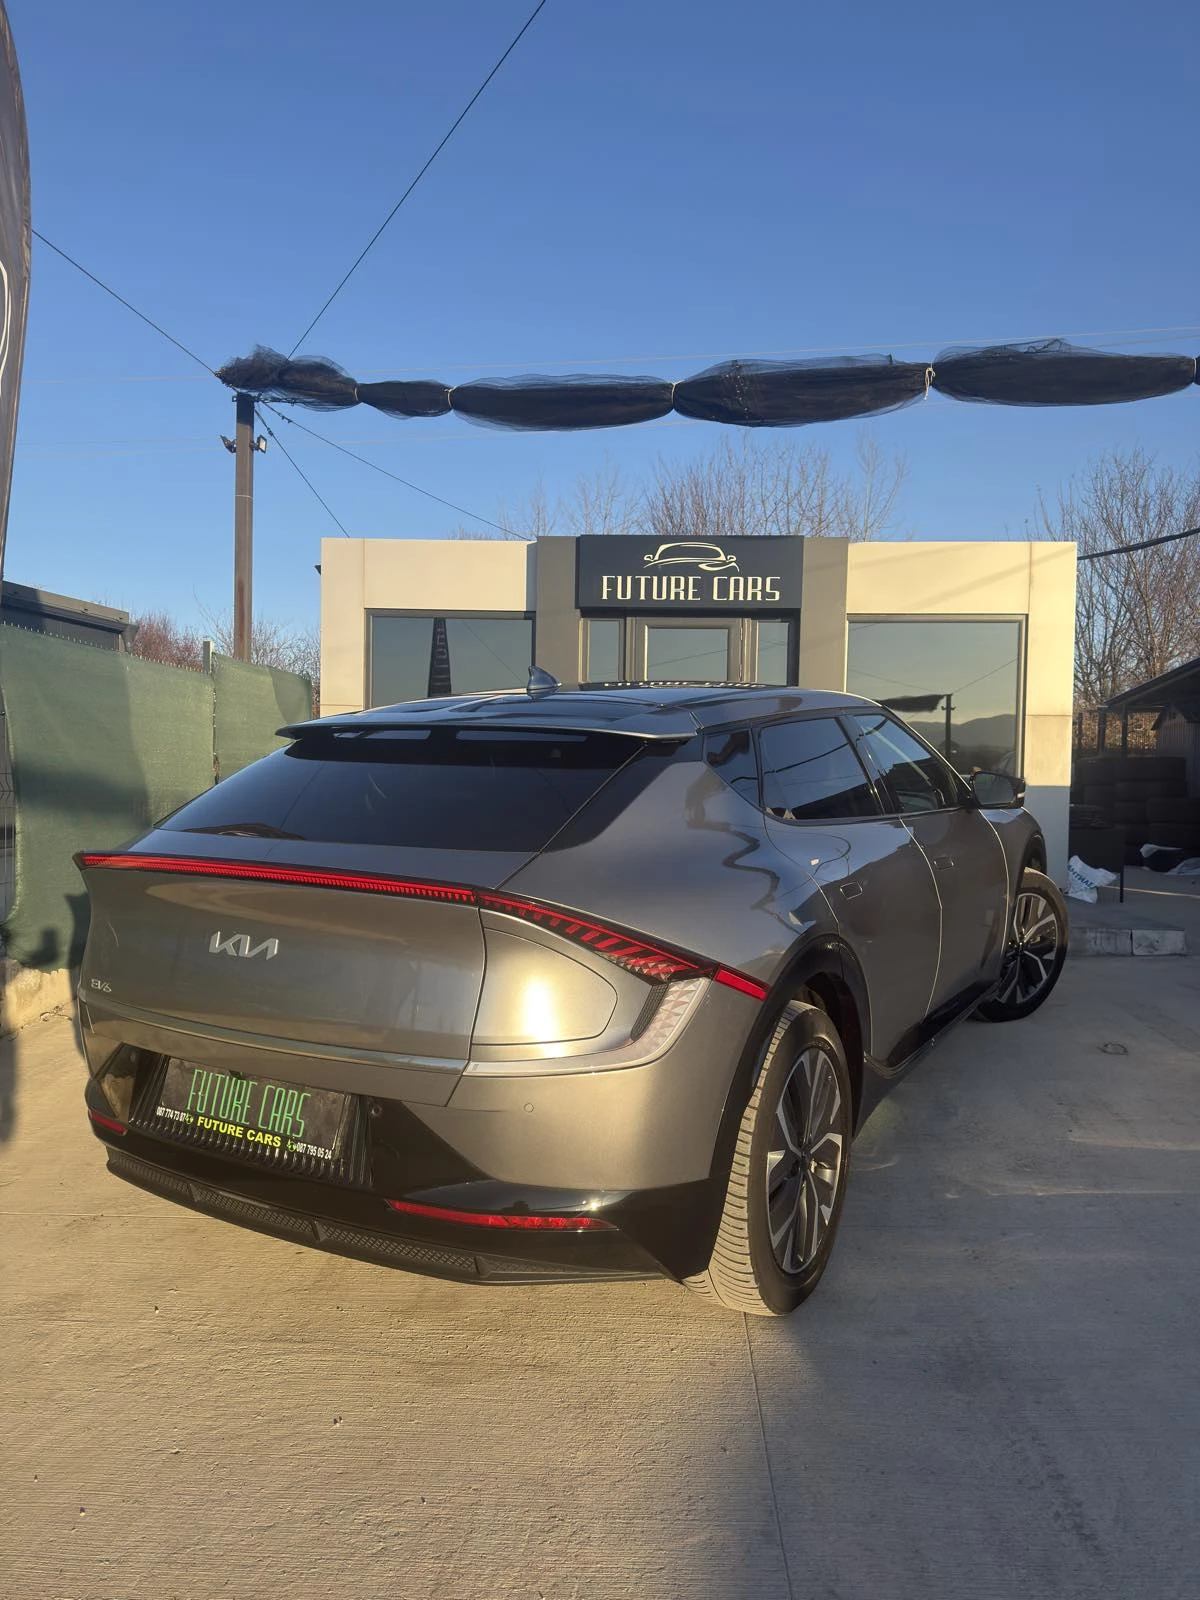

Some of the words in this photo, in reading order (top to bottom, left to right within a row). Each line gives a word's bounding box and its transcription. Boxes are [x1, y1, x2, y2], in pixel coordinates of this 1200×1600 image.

[601, 575, 702, 601] FUTURE
[712, 576, 781, 601] CARS
[208, 930, 279, 961] KIA
[91, 978, 112, 993] EV6
[186, 1069, 258, 1126] FUTURE
[258, 1084, 311, 1138] CARS
[196, 1116, 243, 1139] FUTURE
[246, 1129, 281, 1148] CARS
